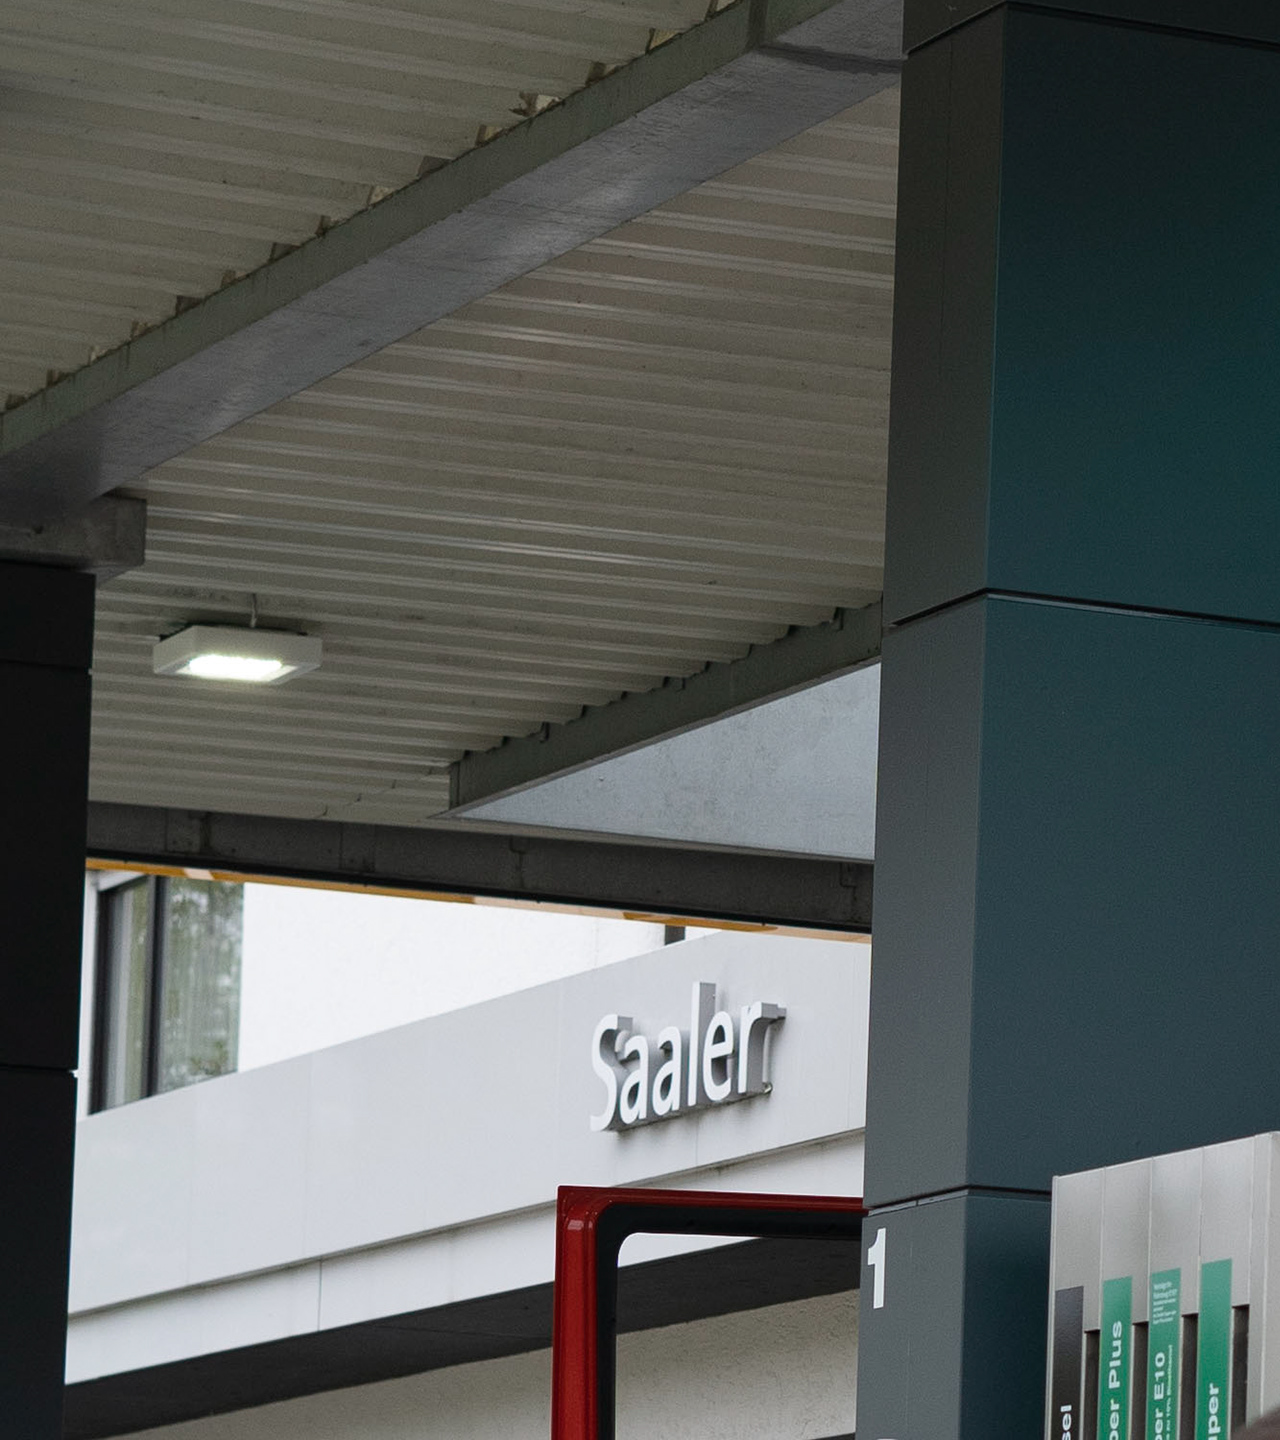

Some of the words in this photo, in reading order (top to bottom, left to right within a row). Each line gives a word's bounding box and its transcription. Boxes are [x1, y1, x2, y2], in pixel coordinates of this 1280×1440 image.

[589, 981, 786, 1133] Saaler
[867, 1227, 887, 1309] 1
[1108, 1320, 1123, 1389] Plus
[1153, 1351, 1166, 1400] E10
